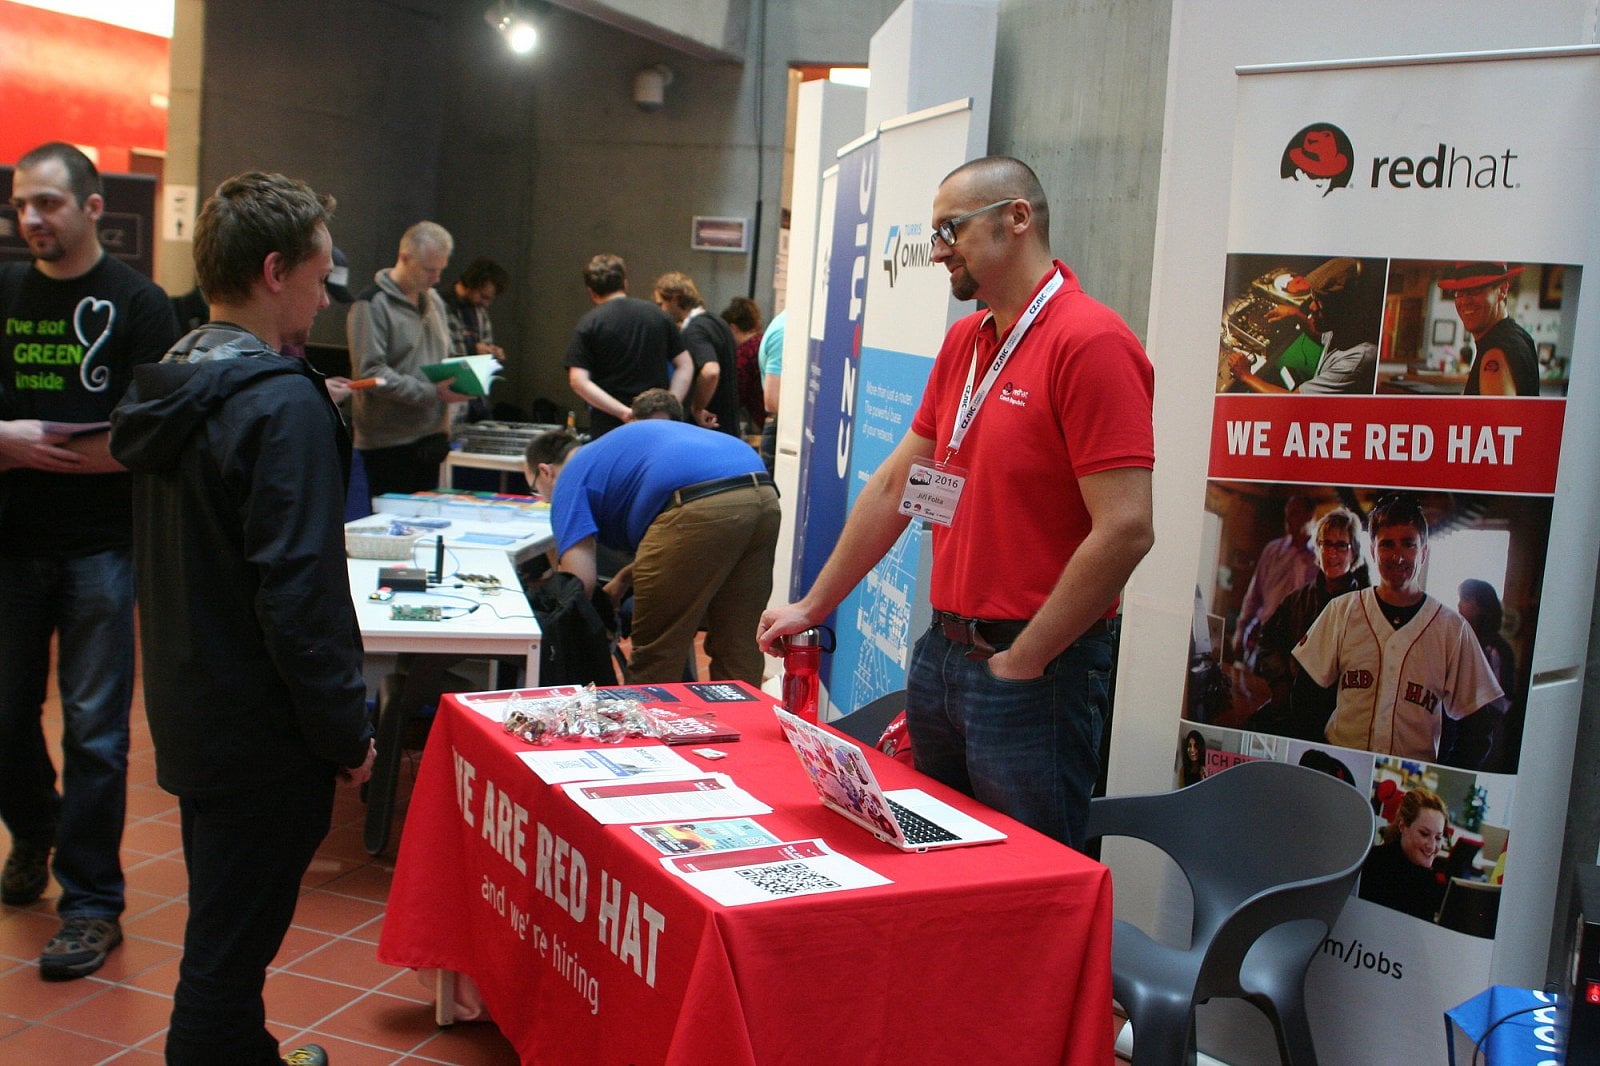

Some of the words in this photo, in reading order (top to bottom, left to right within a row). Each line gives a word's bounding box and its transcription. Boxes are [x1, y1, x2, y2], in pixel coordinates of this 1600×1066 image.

[1371, 143, 1518, 189] redhat
[14, 343, 83, 365] GREEN
[1226, 420, 1272, 456] WE
[1282, 422, 1352, 460] ARE
[1364, 423, 1434, 462] RED
[1447, 425, 1522, 465] HAT
[935, 475, 959, 488] 2016
[1207, 752, 1229, 768] ICH
[482, 779, 529, 877] ARE
[535, 821, 588, 923] RED
[599, 869, 665, 989] HAT
[481, 874, 505, 917] and
[553, 933, 598, 1015] hiring
